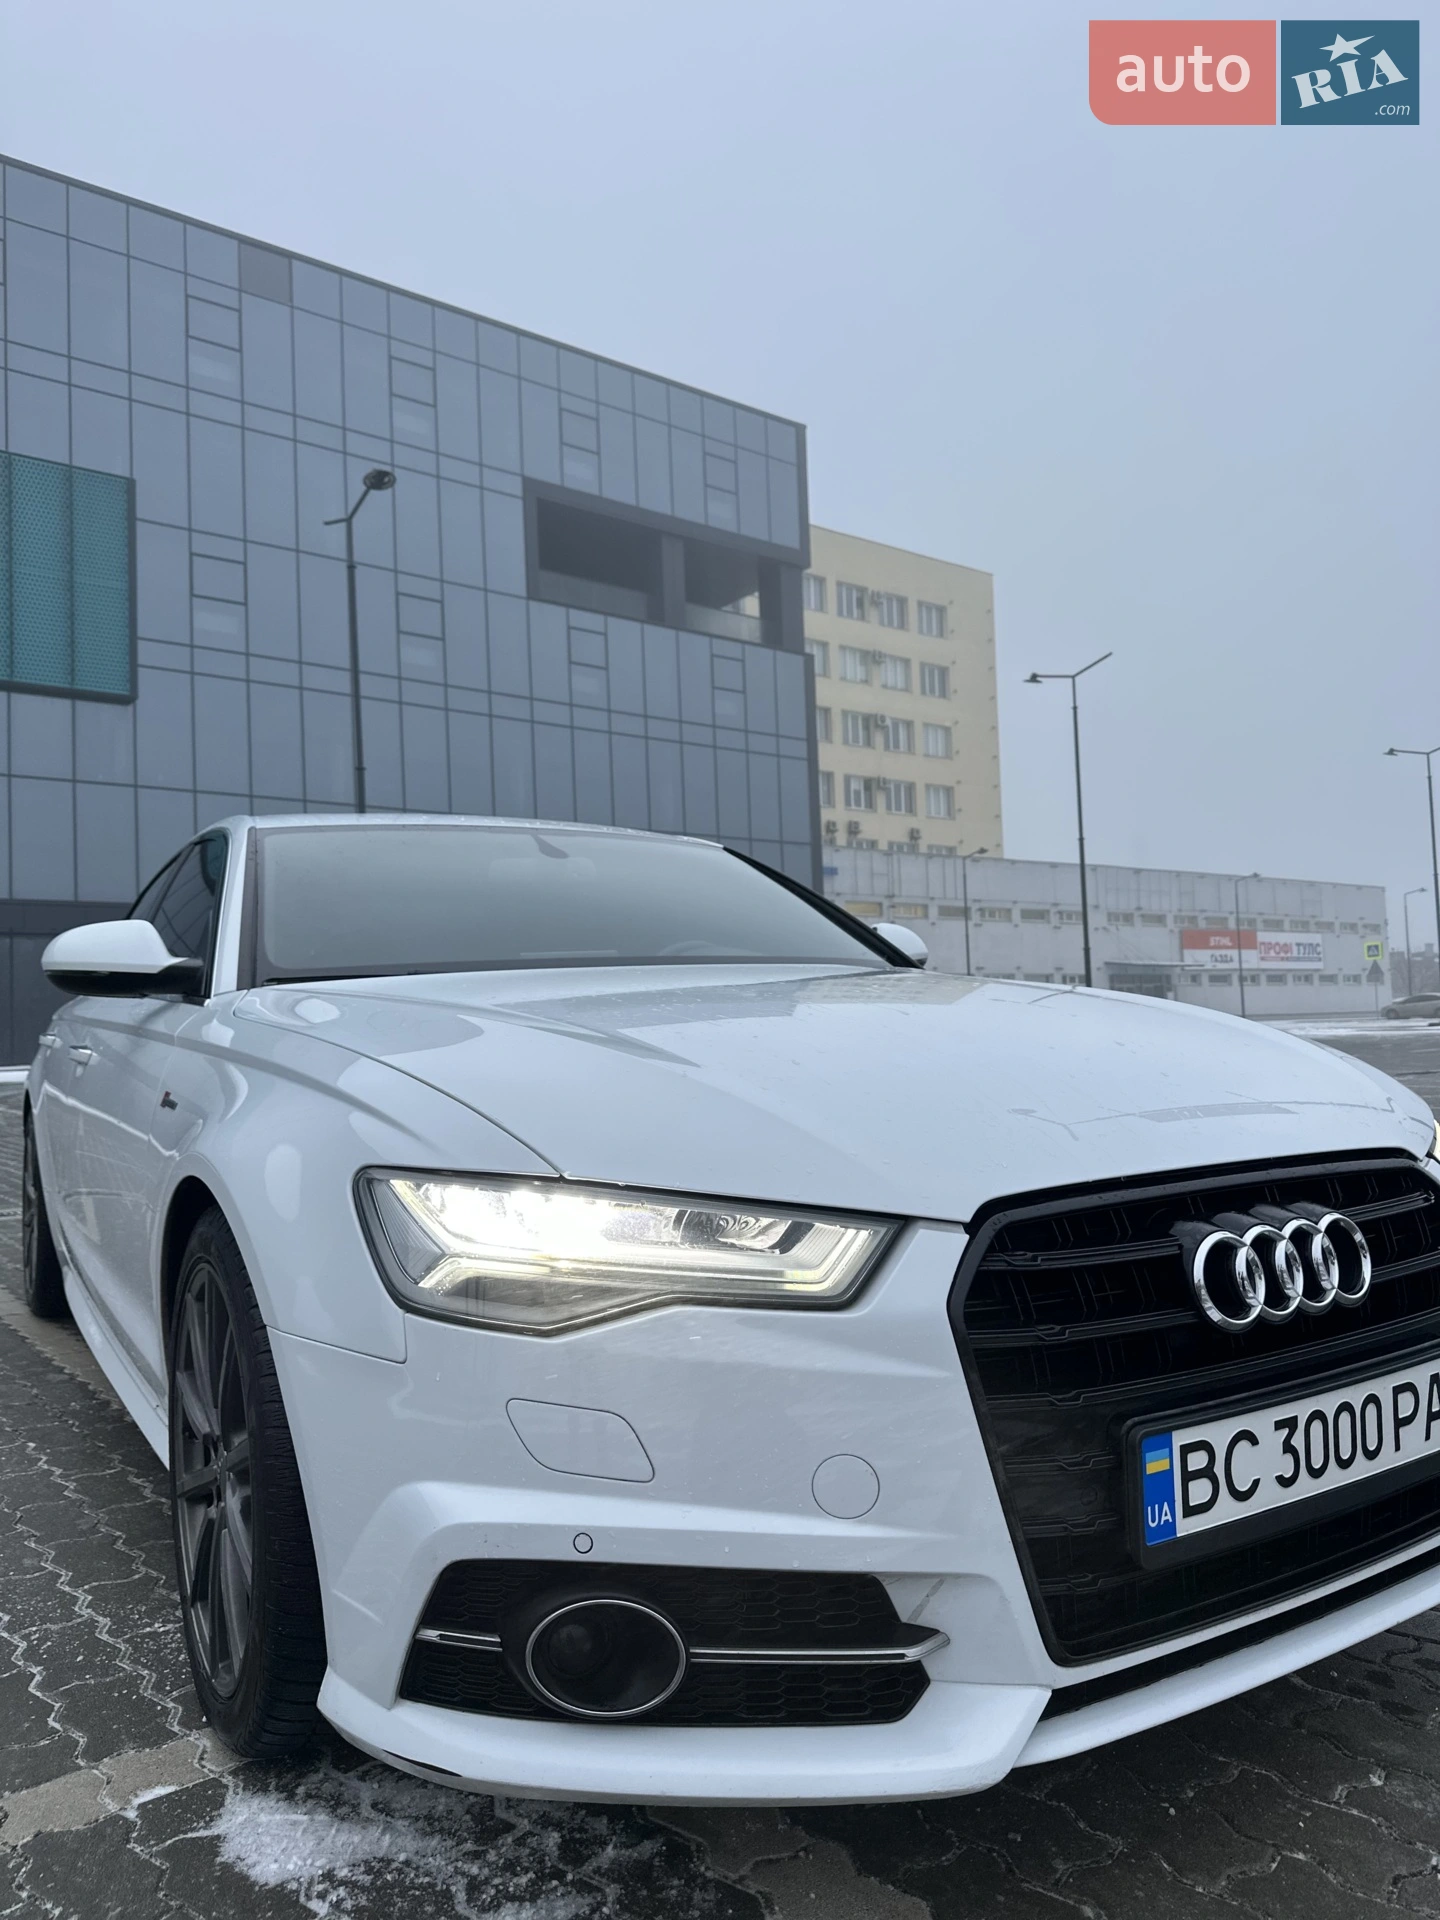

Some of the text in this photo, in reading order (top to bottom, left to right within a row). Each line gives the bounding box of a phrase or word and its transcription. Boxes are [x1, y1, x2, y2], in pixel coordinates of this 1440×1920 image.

[1209, 936, 1232, 946] STIHL
[1295, 942, 1322, 955] ТУЛС
[1178, 1428, 1261, 1519] BC
[1273, 1393, 1384, 1488] 3000
[1147, 1501, 1173, 1528] UA
